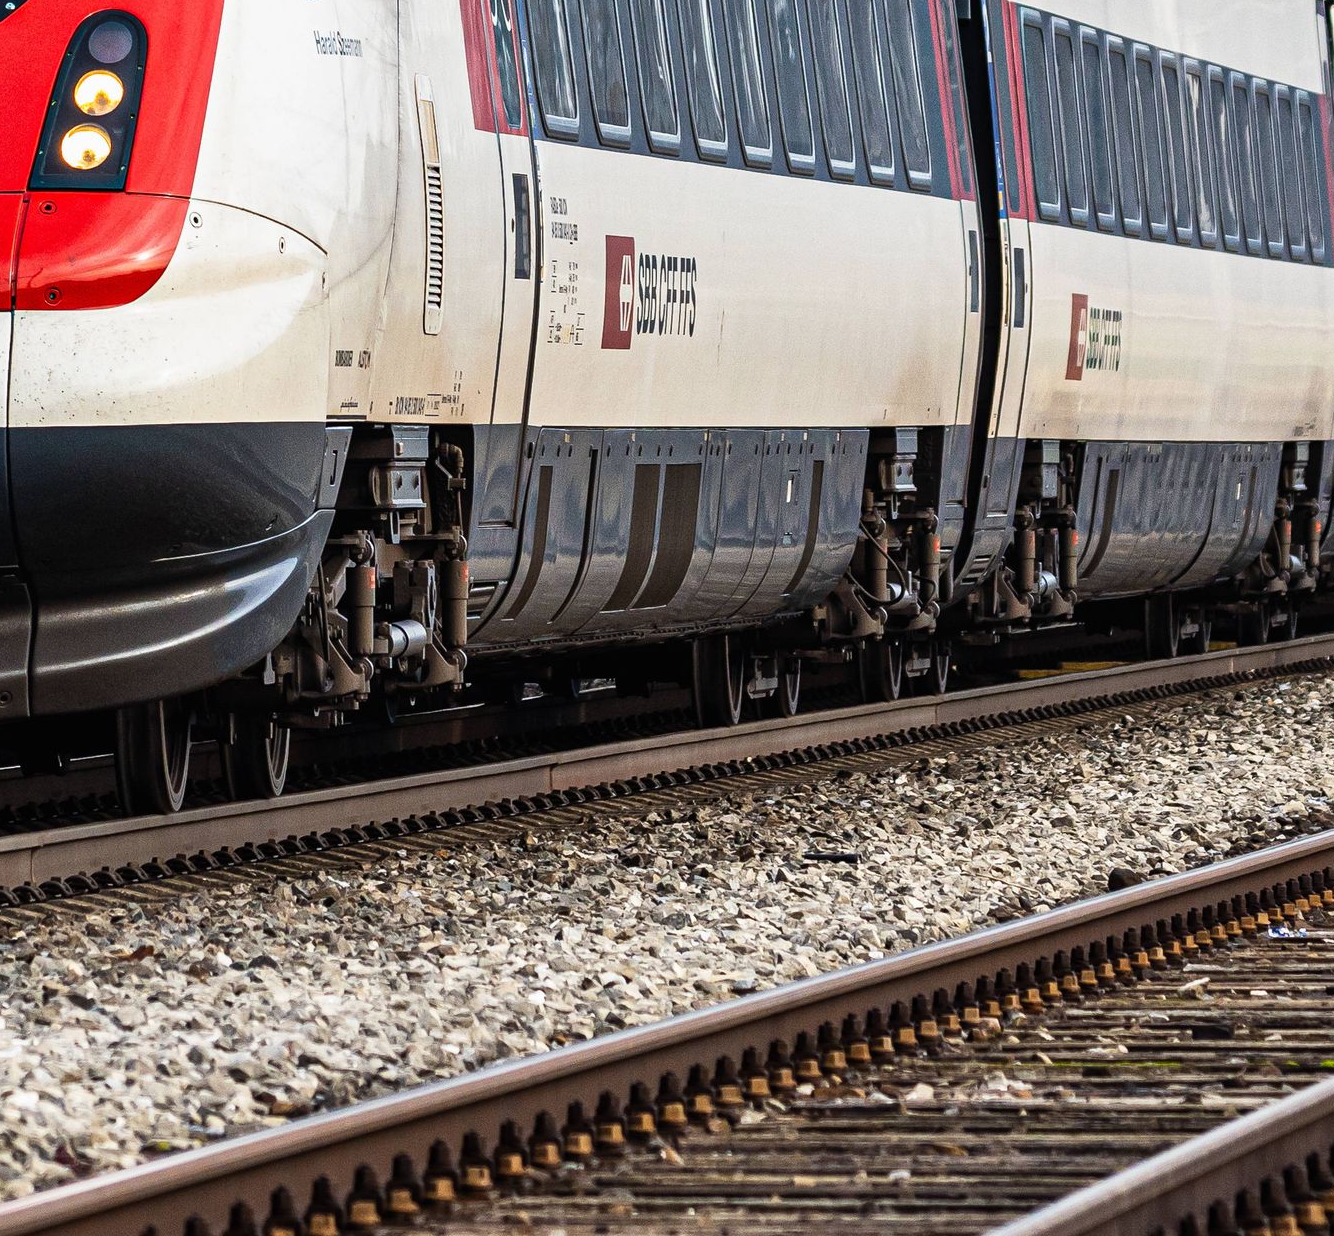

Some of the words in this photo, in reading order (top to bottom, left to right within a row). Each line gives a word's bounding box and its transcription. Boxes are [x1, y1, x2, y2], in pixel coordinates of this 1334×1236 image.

[636, 252, 657, 335] SBB
[658, 254, 678, 336] CFF
[677, 256, 697, 337] FFS
